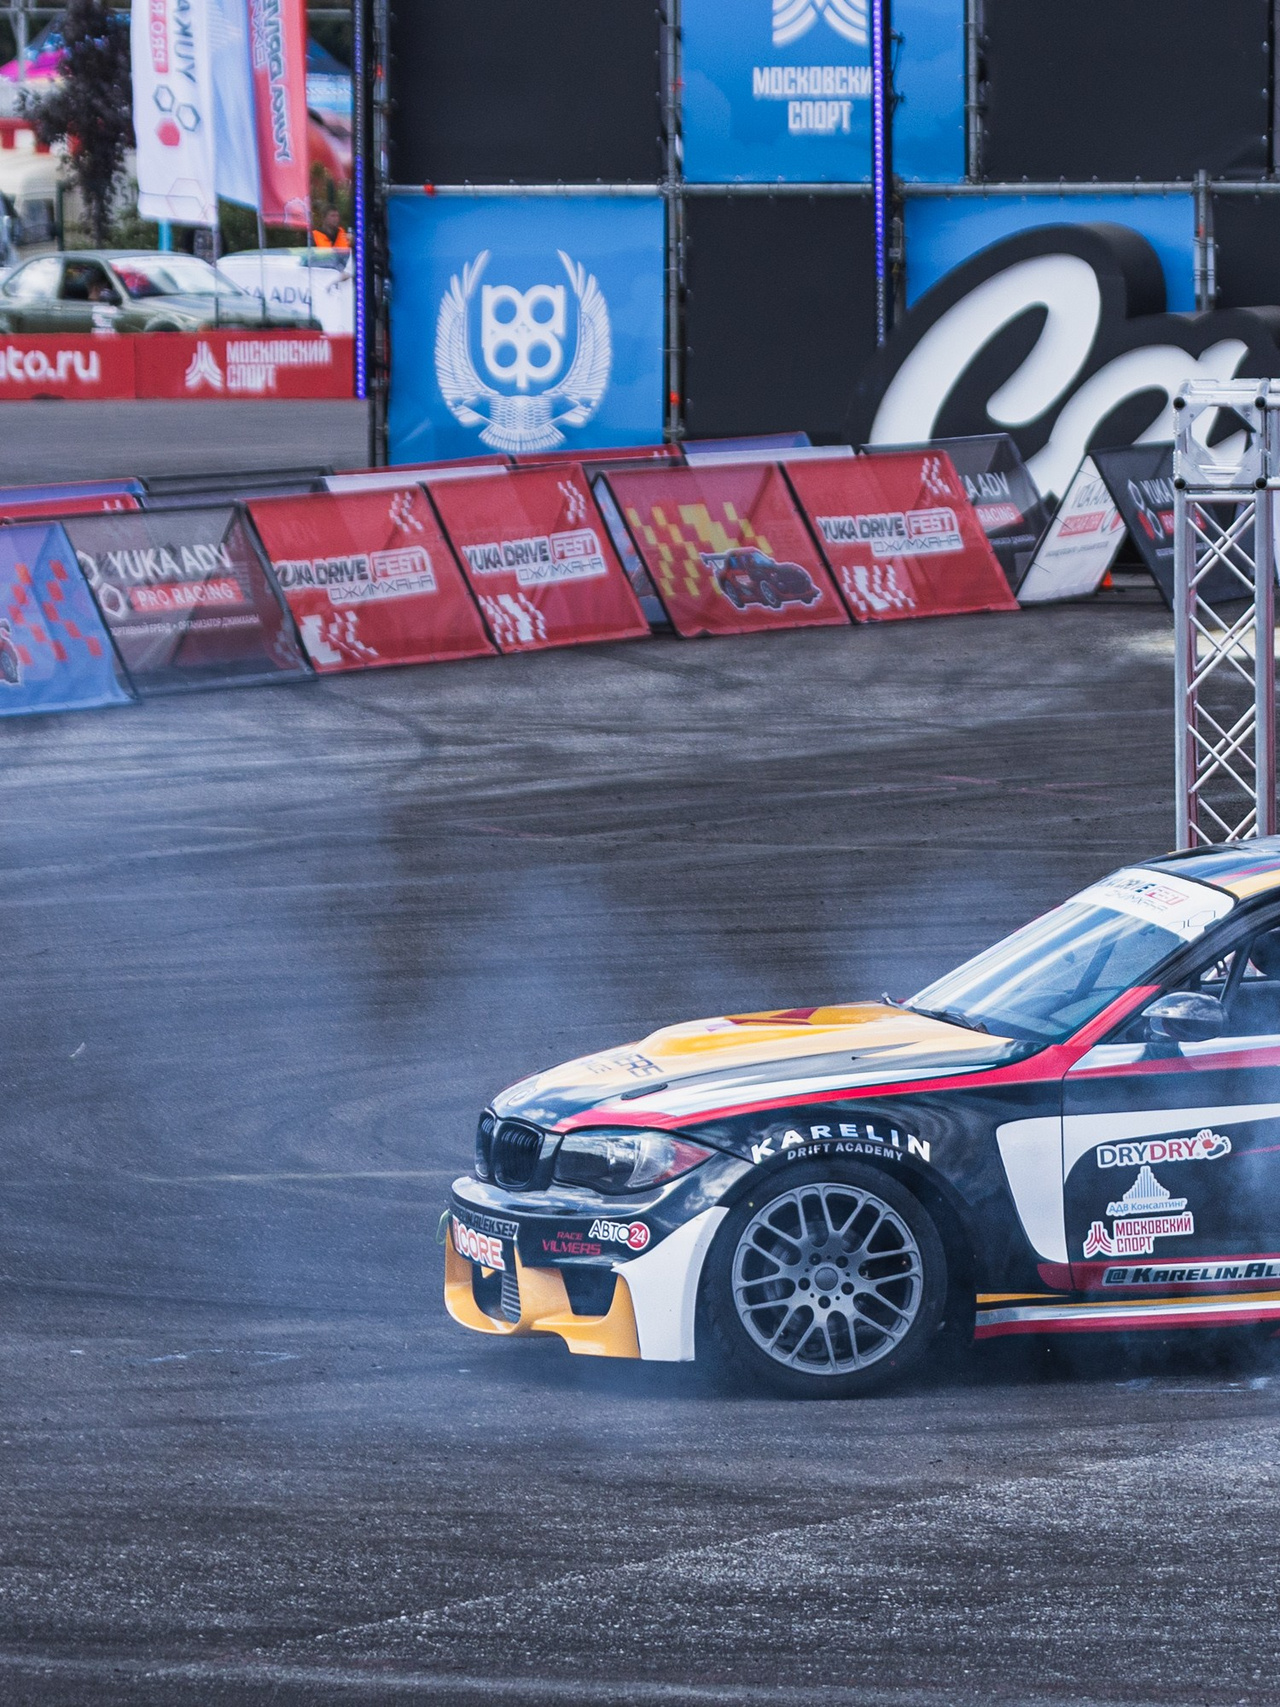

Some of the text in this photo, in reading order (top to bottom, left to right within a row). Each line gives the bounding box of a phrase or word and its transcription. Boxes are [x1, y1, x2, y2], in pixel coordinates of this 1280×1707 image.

[753, 66, 871, 97] МОСКОВСКИ
[788, 101, 852, 131] СПОРТ
[226, 339, 330, 364] МОСКОВСКИЙ
[226, 364, 276, 390] СПОРТ
[980, 472, 1010, 496] ADV
[819, 514, 952, 540] YUKA DRIVE FEST
[978, 505, 1016, 524] RACING
[107, 543, 233, 579] YUKA ADV
[464, 537, 596, 571] YUKA DRIVE FEST
[315, 558, 369, 585] DRIVE
[376, 552, 424, 577] FEST
[135, 582, 235, 606] PRO RACING
[750, 1123, 931, 1164] KARELIN
[787, 1142, 903, 1161] DRIFT ACADEMY
[1100, 1139, 1198, 1166] DRYDRY
[1109, 1200, 1186, 1214] АДВ Консалтинг
[556, 1231, 583, 1241] RACE
[1115, 1214, 1192, 1237] МОСКОВСКИЙ
[542, 1240, 602, 1256] VILMERS
[1116, 1236, 1152, 1253] СПОРТ
